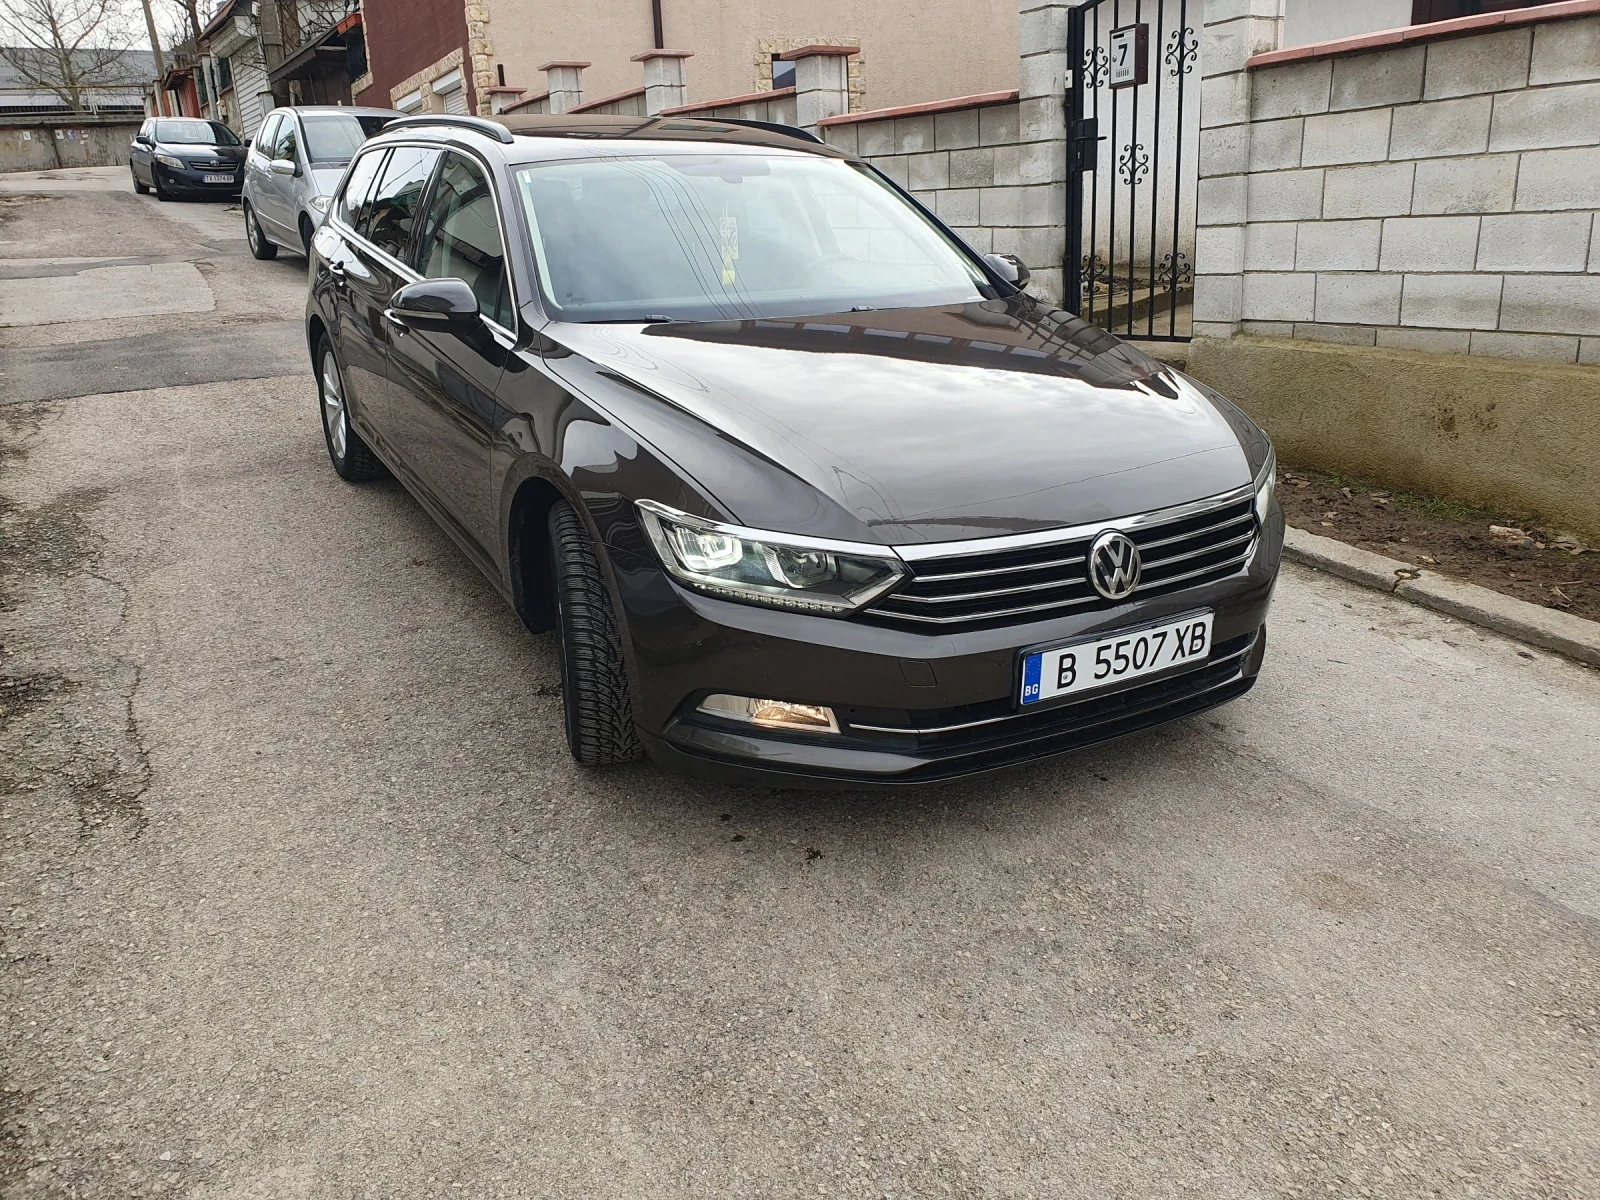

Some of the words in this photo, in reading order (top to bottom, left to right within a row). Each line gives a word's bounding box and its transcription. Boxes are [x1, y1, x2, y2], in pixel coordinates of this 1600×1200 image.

[1118, 43, 1128, 66] 7
[1092, 532, 1139, 598] VW
[1057, 653, 1077, 689] B
[1094, 631, 1168, 679] 5507
[1170, 621, 1206, 661] XB
[1024, 683, 1039, 697] BG
